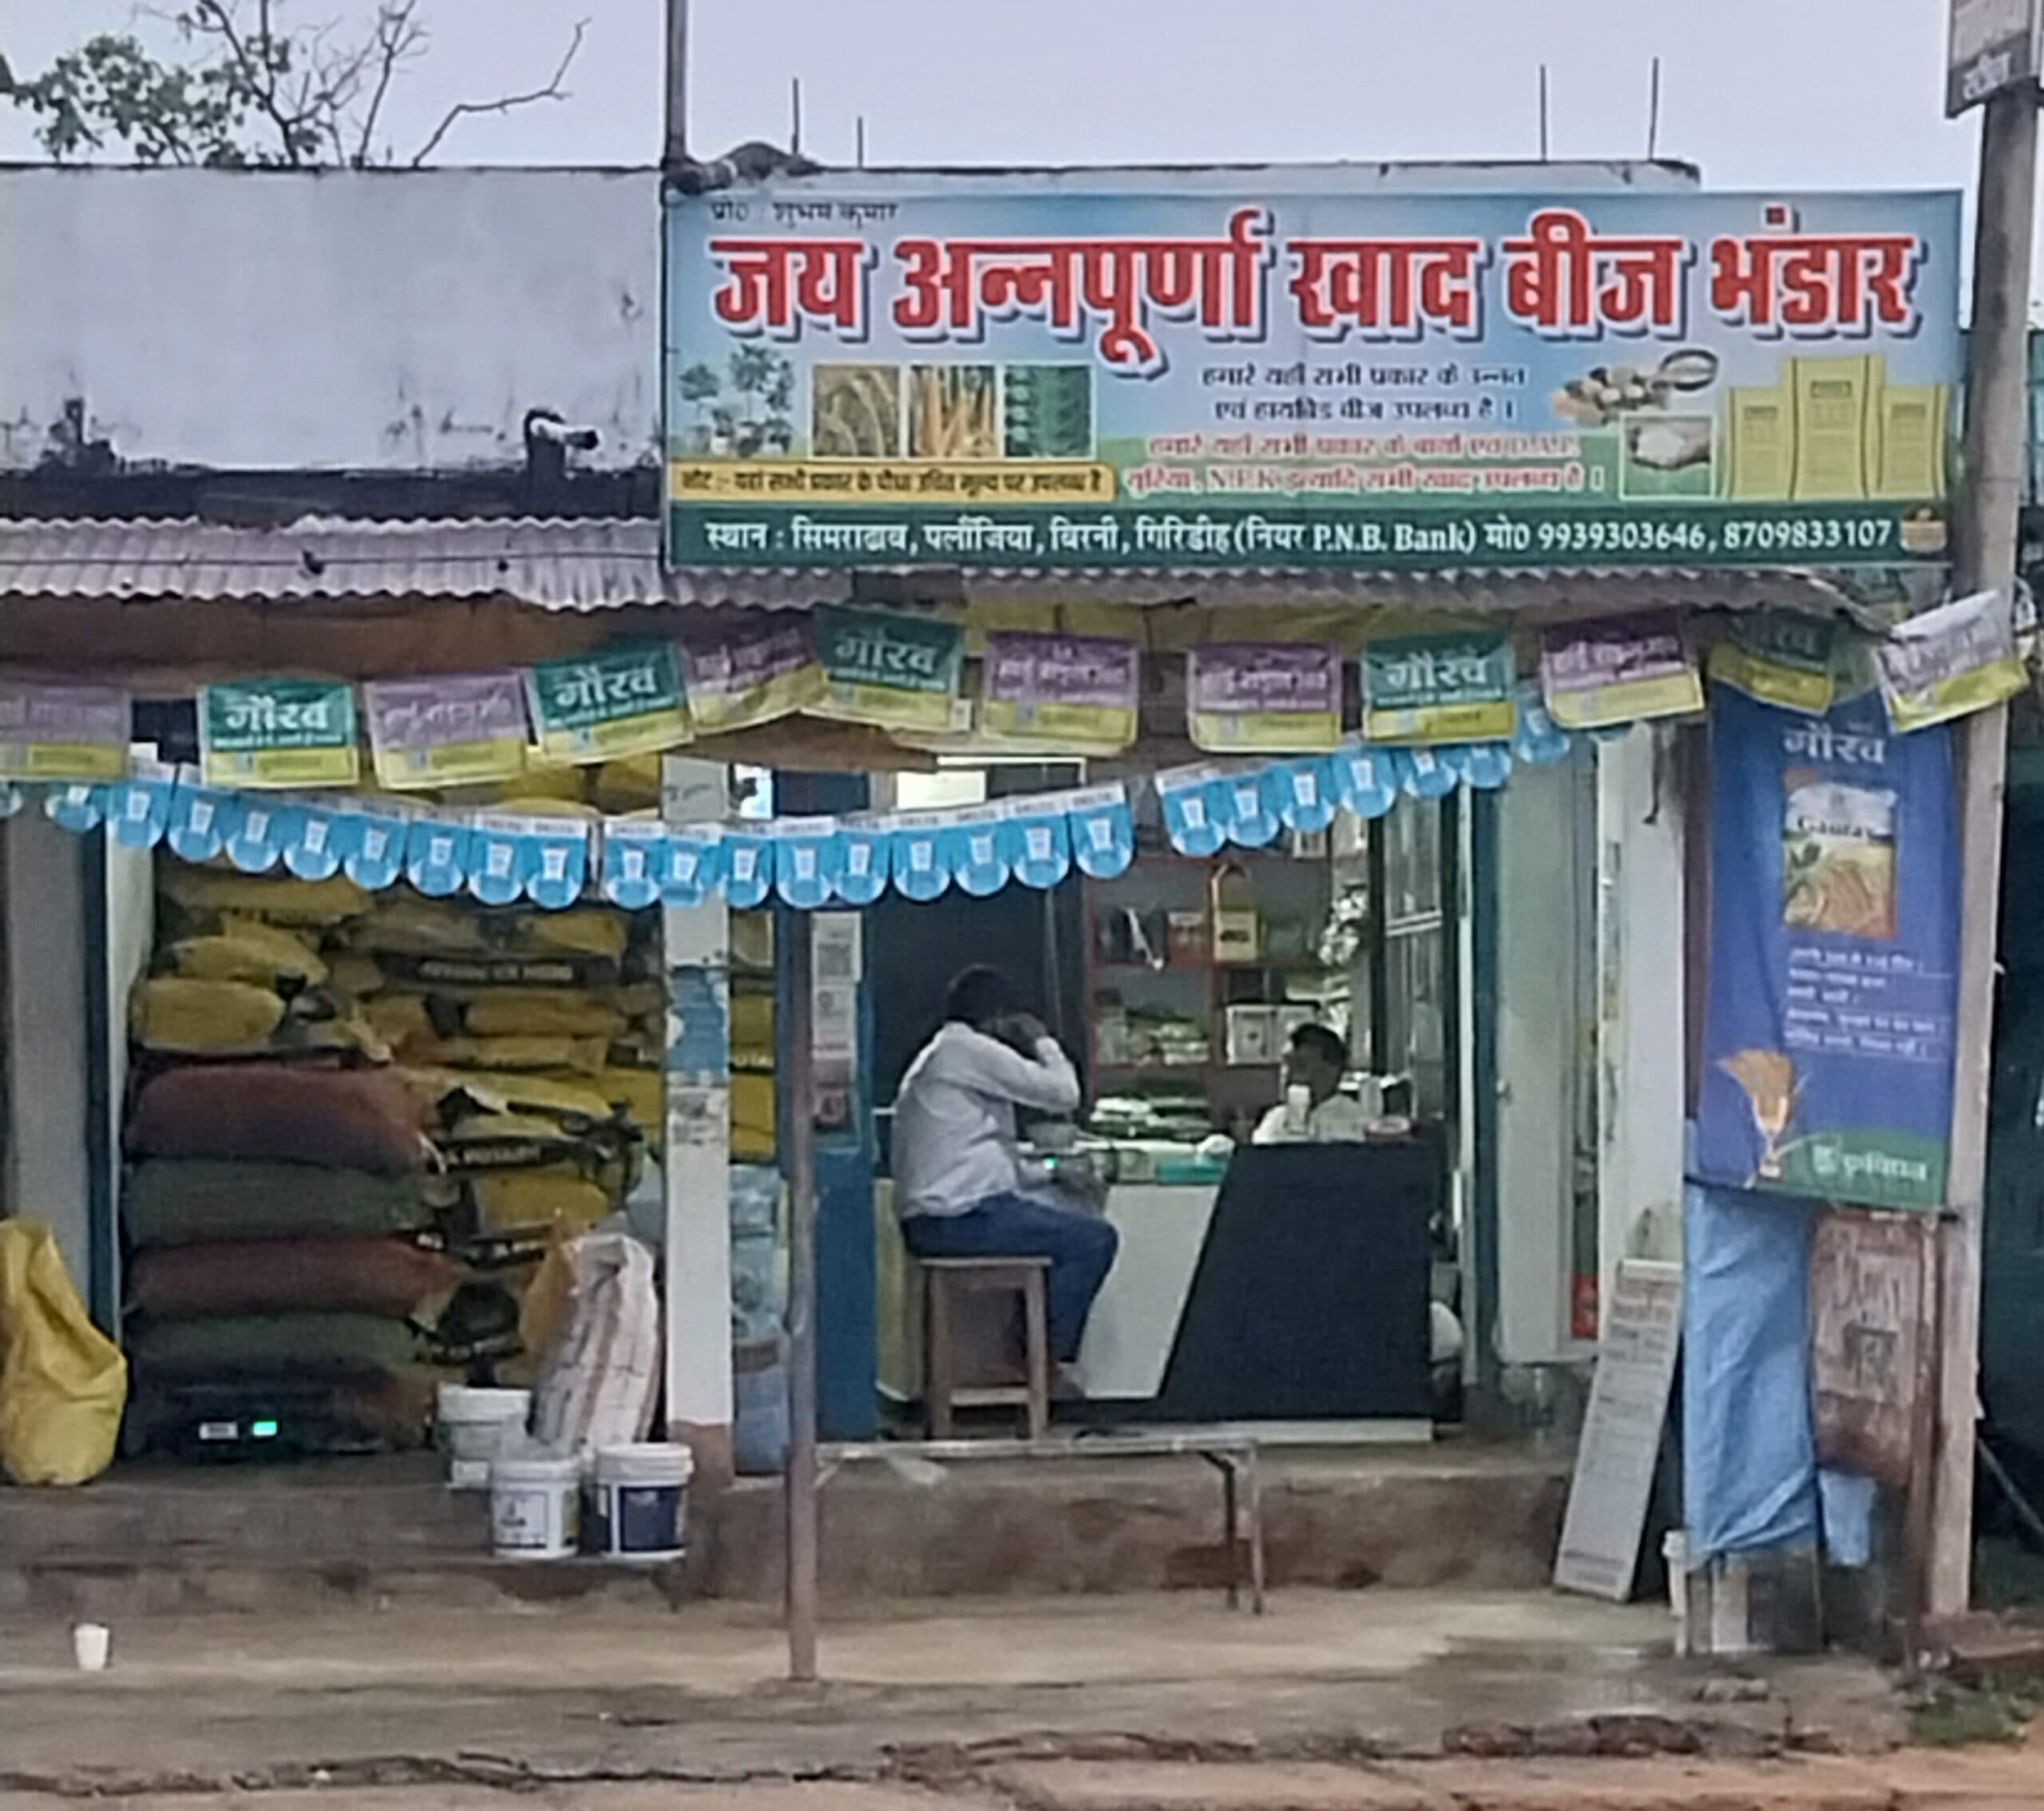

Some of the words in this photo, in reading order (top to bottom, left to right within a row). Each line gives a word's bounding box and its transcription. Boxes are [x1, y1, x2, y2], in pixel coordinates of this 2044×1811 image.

[707, 240, 870, 337] जय
[892, 207, 1273, 374] अन्नपूर्णा
[1287, 236, 1484, 339] खाद
[1502, 208, 1688, 339] बीज
[1709, 205, 1922, 339] भंडार
[1202, 362, 1256, 386] हमारे
[1314, 362, 1361, 386] सभी
[1369, 367, 1429, 386] प्रकार
[1436, 362, 1460, 386] के
[1340, 396, 1384, 419] बीज
[1478, 396, 1494, 419] है
[704, 522, 769, 550] स्थान
[1313, 523, 1388, 551] P.N.B.
[1394, 519, 1476, 554] Bank)
[1537, 521, 1717, 553] 9939303646,
[1723, 519, 1892, 549] 8709833107
[553, 664, 660, 709] गौरव
[224, 692, 331, 732] गौरव
[1781, 719, 1886, 764] गौरव
